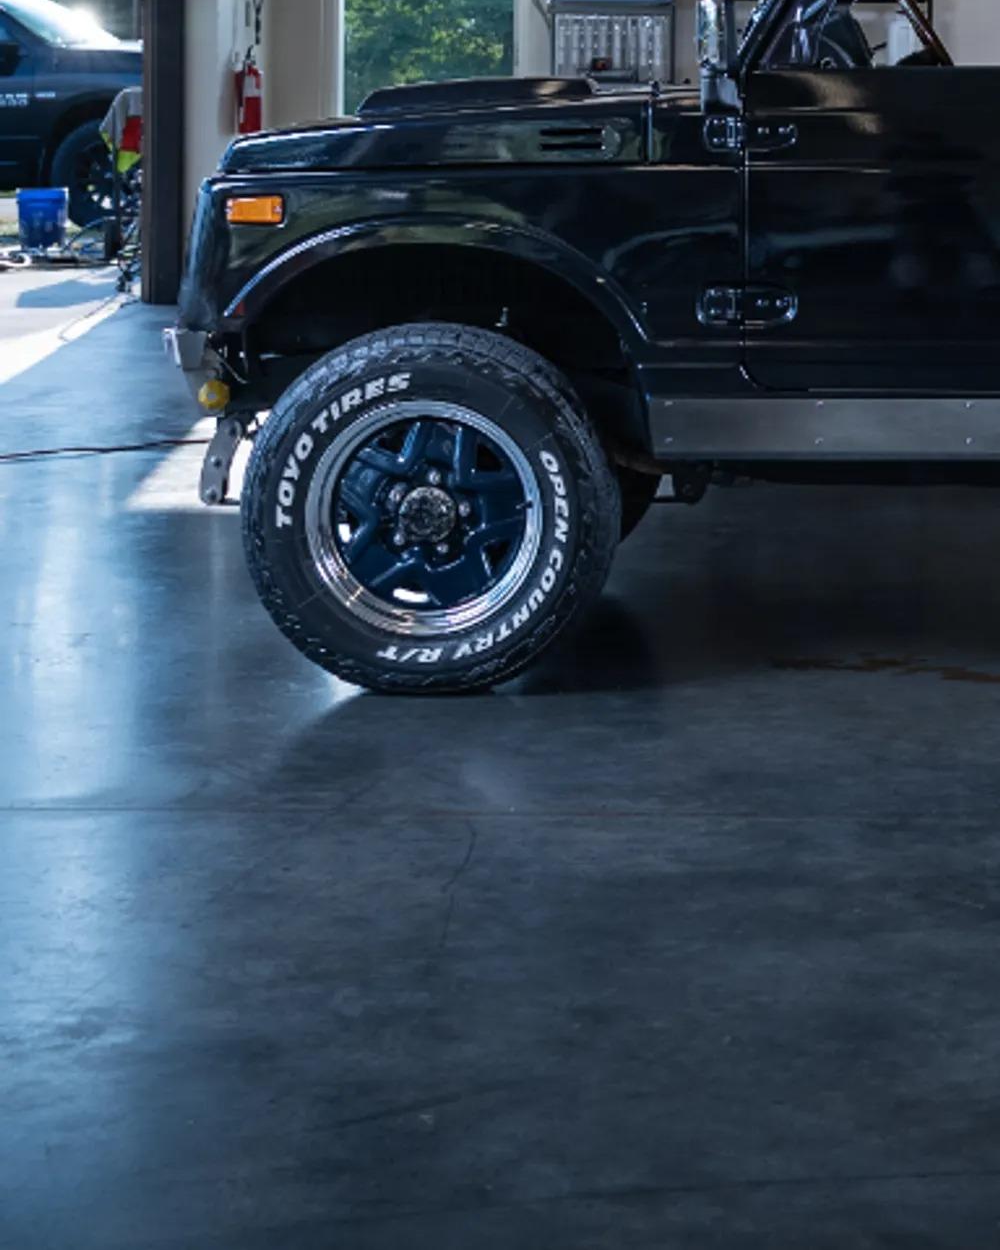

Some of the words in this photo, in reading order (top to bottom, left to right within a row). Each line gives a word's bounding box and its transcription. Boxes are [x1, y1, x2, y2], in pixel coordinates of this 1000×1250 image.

[276, 431, 315, 529] TOYO
[310, 372, 412, 434] TIRES
[539, 450, 570, 544] OPEN
[376, 644, 443, 663] R/T
[452, 548, 564, 660] COUNTRY
